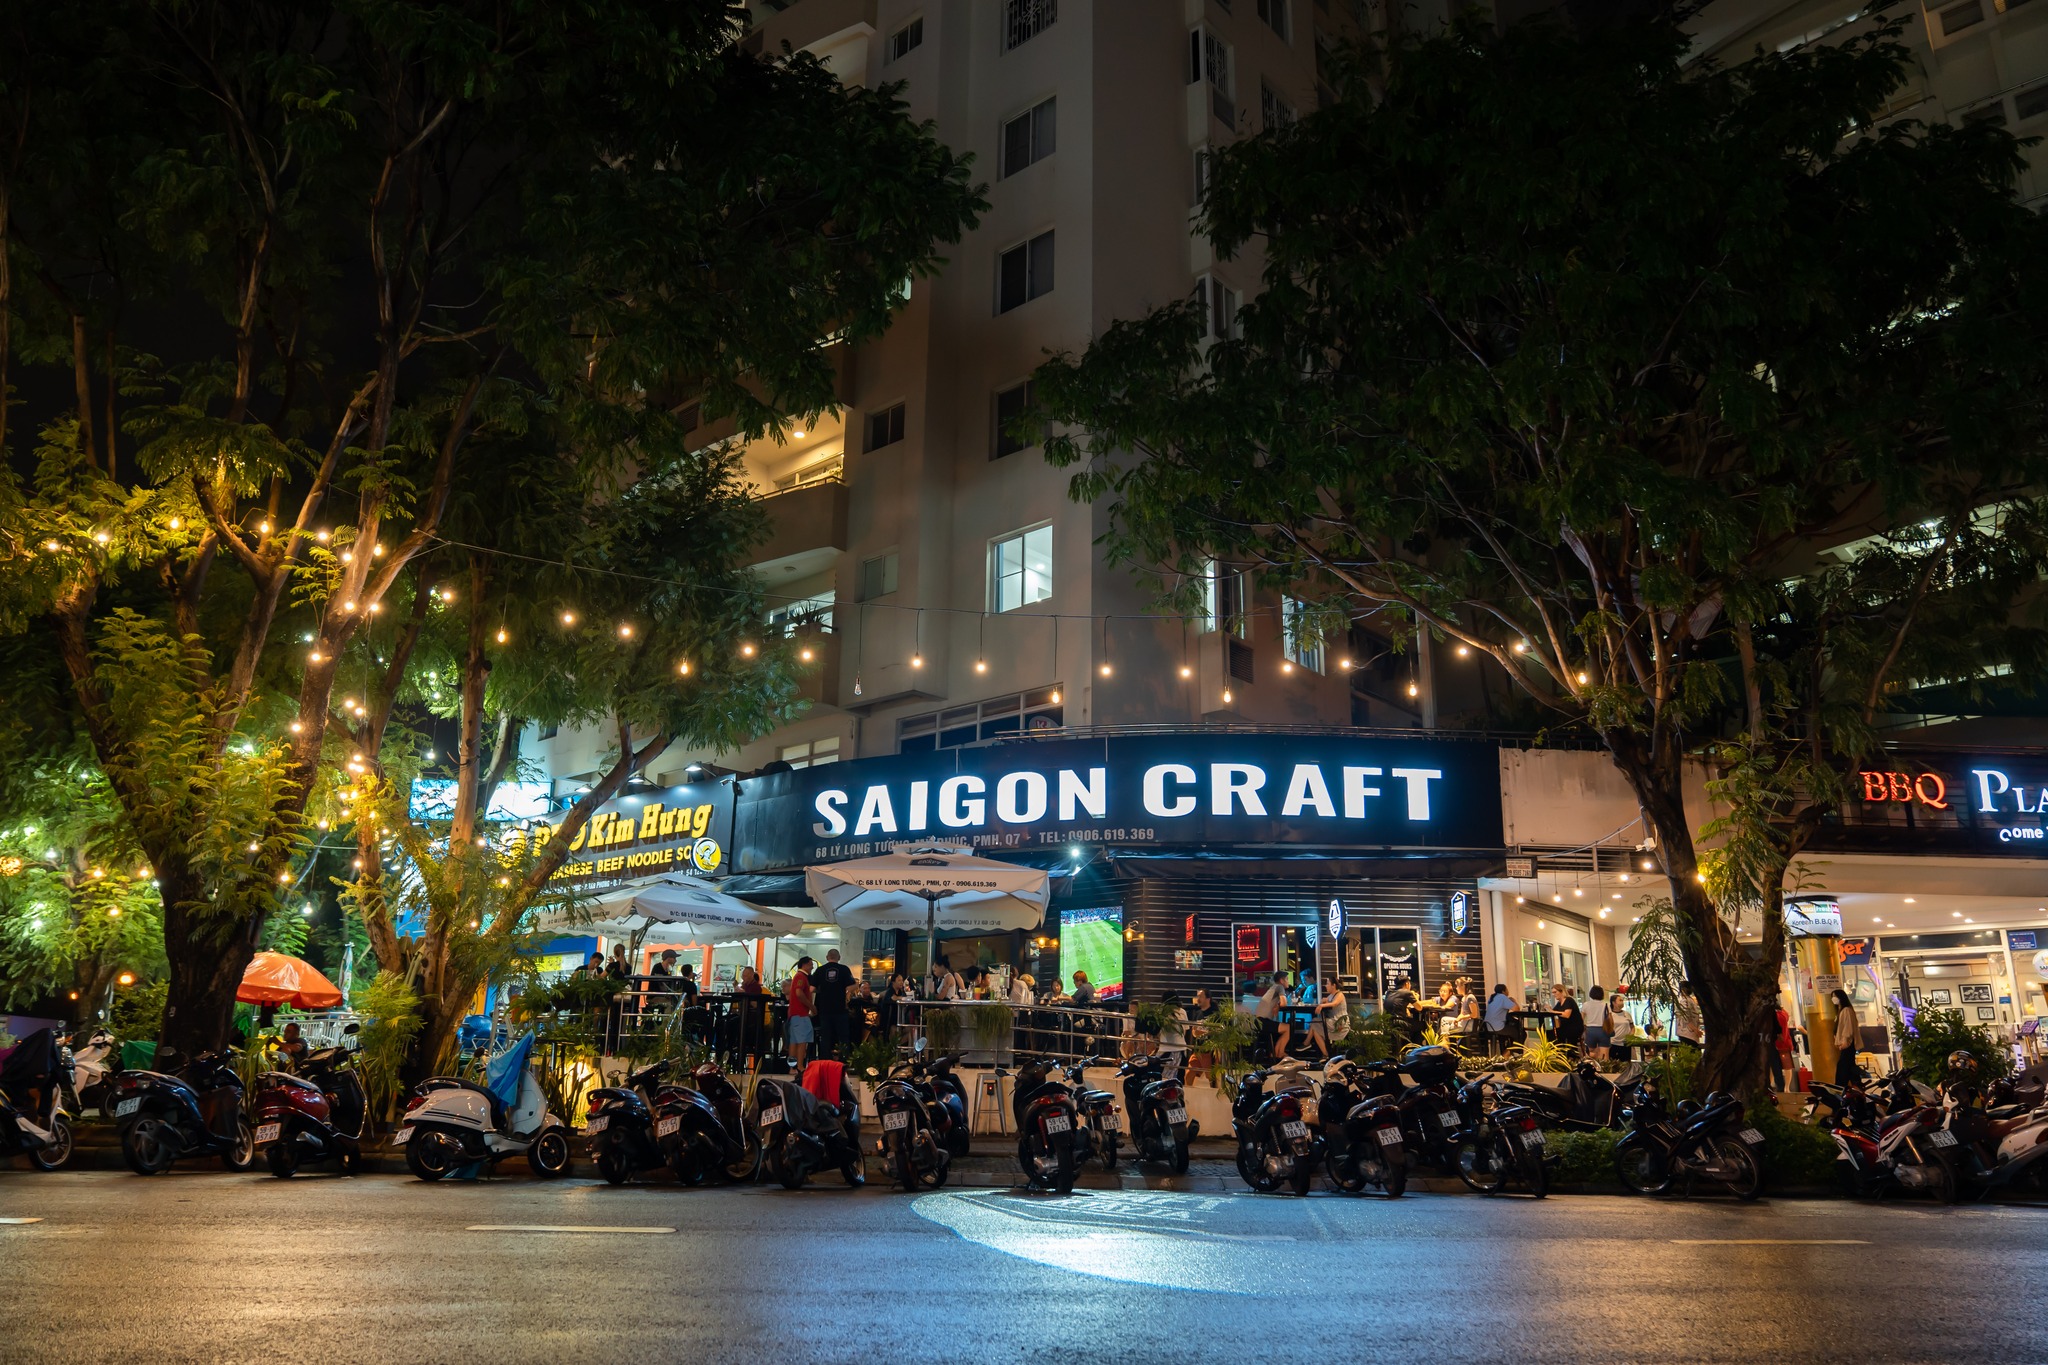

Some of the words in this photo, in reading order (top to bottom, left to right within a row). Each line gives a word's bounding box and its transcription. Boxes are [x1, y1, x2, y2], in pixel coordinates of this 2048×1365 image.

[812, 767, 1106, 839] SAIGON
[1144, 763, 1442, 821] CRAFT
[1859, 771, 1948, 809] BBQ
[587, 811, 635, 848] Kim
[638, 803, 714, 839] Hưng
[2000, 827, 2044, 842] Come
[596, 855, 625, 873] BEEF
[627, 848, 674, 869] NOODLE
[815, 847, 827, 859] 68
[830, 842, 840, 857] LÝ
[844, 843, 871, 856] LONG
[1005, 833, 1021, 846] Q7
[1068, 828, 1155, 841] 0906.619.369
